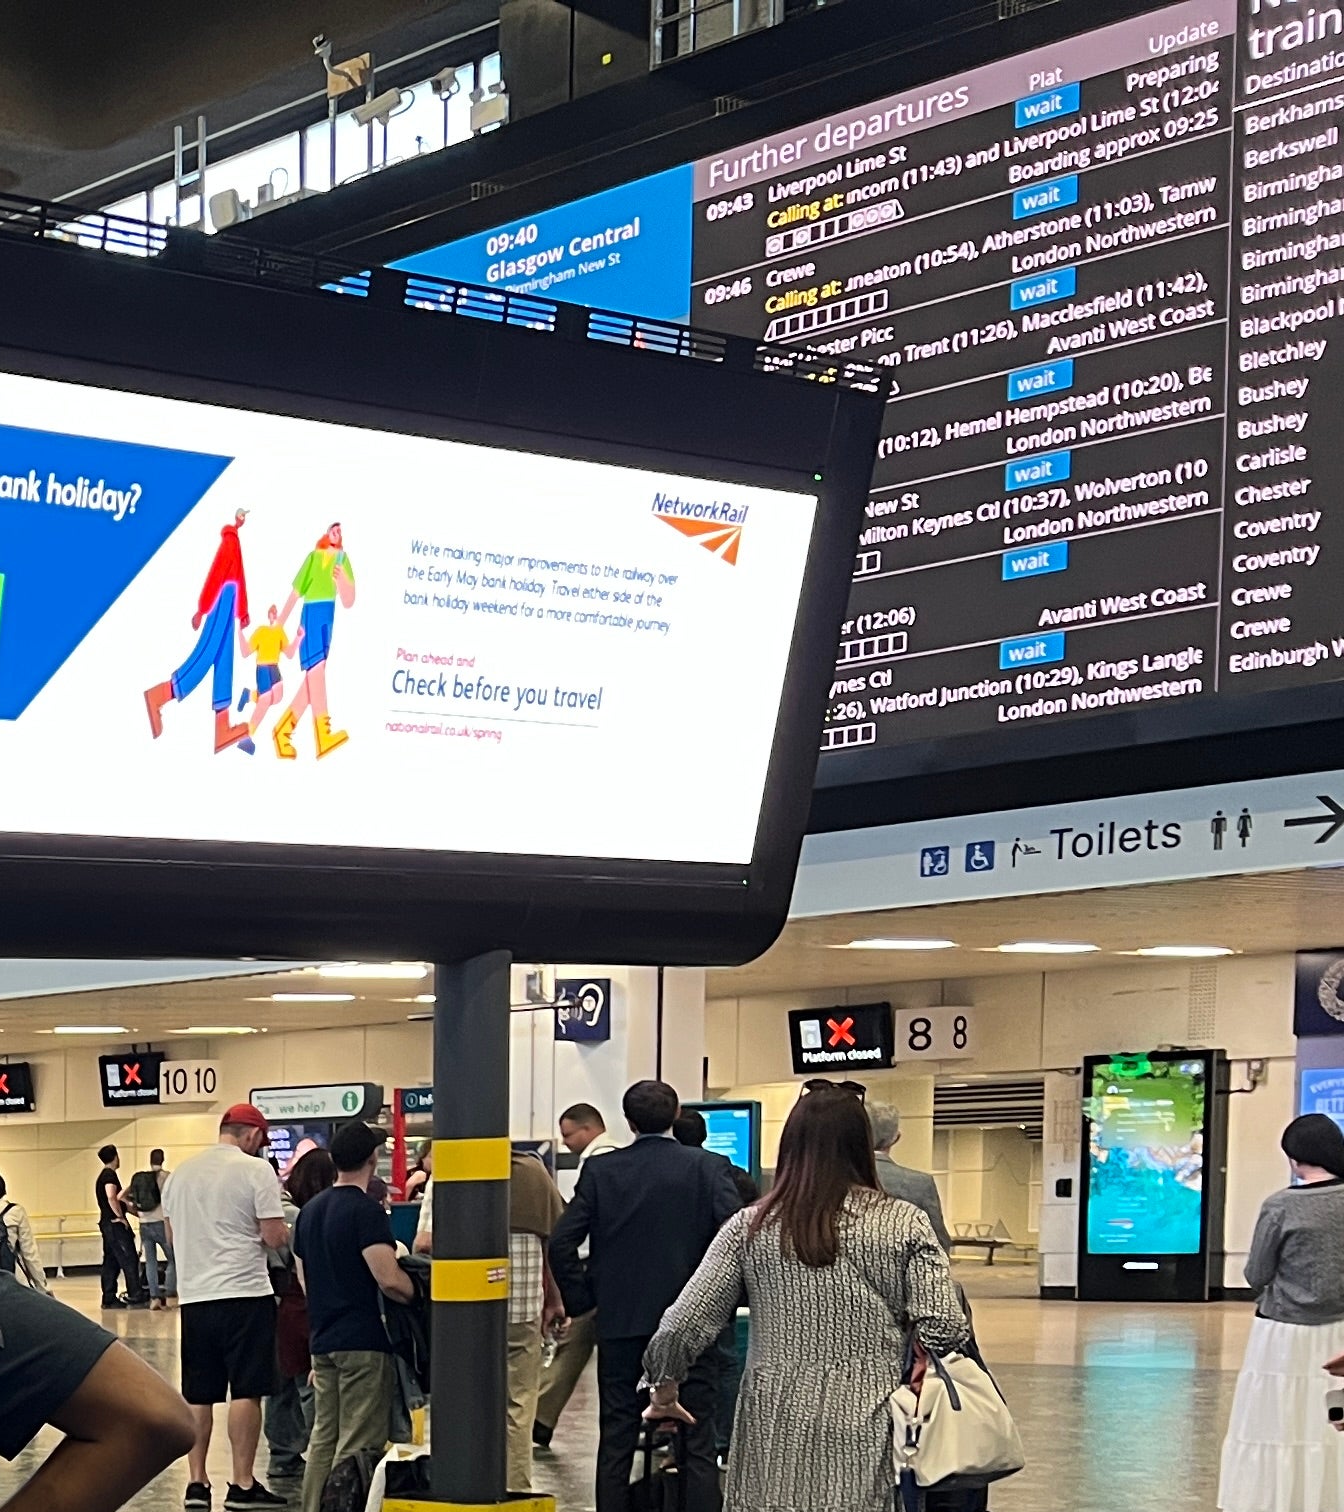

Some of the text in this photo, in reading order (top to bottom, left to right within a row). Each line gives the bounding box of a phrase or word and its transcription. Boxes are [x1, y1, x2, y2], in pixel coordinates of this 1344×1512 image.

[1148, 20, 1219, 54] Update
[1248, 8, 1343, 60] train
[1029, 67, 1063, 91] Plat
[1126, 50, 1219, 92] Preparing
[1024, 94, 1062, 119] wait
[708, 85, 970, 189] Further departures
[1009, 107, 1219, 184] Boarding approx 09:25
[1244, 126, 1339, 169] Berkswell
[766, 96, 1161, 229] Calling (11:43) and Liverpool Lime St
[706, 145, 907, 222] 09:43 Liverpool Lime St
[1022, 186, 1061, 210] wait
[486, 223, 539, 257] 09:40
[486, 216, 640, 283] Glasgow Central
[764, 286, 818, 314] Calling
[914, 241, 979, 275] (10:54),
[982, 213, 1081, 254] Atherstone
[1084, 192, 1155, 228] (11:03),
[1012, 206, 1216, 274] London Northwestern
[578, 259, 605, 276] New
[608, 252, 621, 266] St
[704, 261, 816, 306] 09:46 Crewe
[904, 271, 1209, 363] Trent (11:26), Macclesfield (11:42),
[1046, 299, 1214, 355] Avanti West Coast
[1240, 299, 1335, 338] Blackpool
[1239, 340, 1327, 372] Bletchley
[945, 412, 1002, 441] Hemel
[1006, 387, 1109, 428] Hempstead
[1112, 371, 1184, 407] (10:20),
[1238, 377, 1309, 406] Bushey
[1236, 444, 1307, 473] Carlisle
[46, 473, 141, 520] holiday?
[913, 469, 1172, 537] Keynes (10:37), Wolverton
[1235, 479, 1312, 506] Chester
[1233, 511, 1322, 540] Coventry
[443, 545, 482, 566] making
[485, 551, 514, 568] major
[518, 557, 588, 576] improvements
[591, 563, 601, 576] to
[604, 564, 619, 578] the
[622, 567, 656, 586] railway
[658, 573, 678, 586] over
[1231, 583, 1292, 606] Crewe
[396, 647, 476, 668] Plan ahead and
[1229, 640, 1328, 673] Edinburgh
[392, 669, 603, 711] Check before you travel
[871, 659, 1139, 716] Watford Junction (10:29), Kings
[1050, 818, 1181, 860] Toilets
[908, 1015, 968, 1051] 8 8
[802, 1046, 882, 1064] Platform closed
[163, 1067, 216, 1095] 10 10
[279, 1101, 326, 1115] we help?
